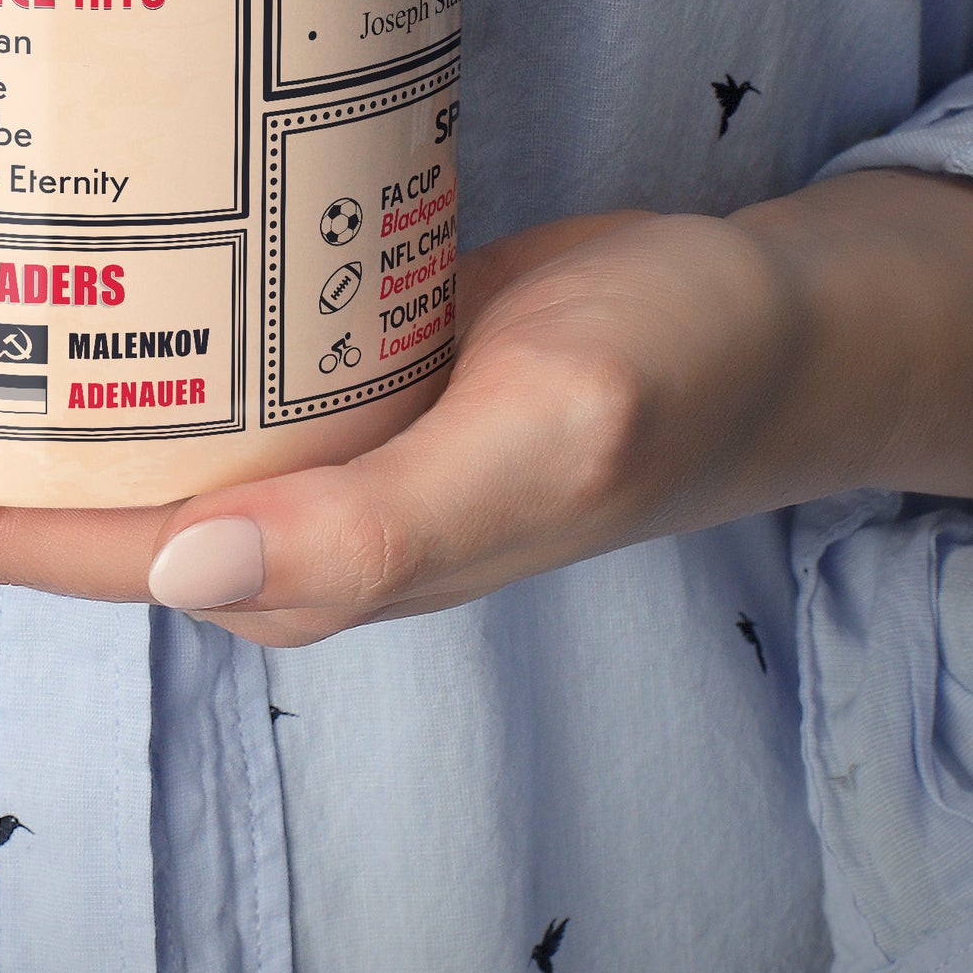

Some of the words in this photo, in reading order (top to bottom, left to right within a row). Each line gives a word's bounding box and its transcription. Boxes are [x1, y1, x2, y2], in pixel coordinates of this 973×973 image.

[10, 165, 129, 202] Eternity
[381, 182, 404, 210] FA
[408, 164, 440, 199] CUP
[381, 177, 456, 238] Blackpool
[380, 255, 437, 300] Detroit
[381, 240, 415, 273] NFL
[379, 294, 428, 333] TOUR
[432, 279, 449, 309] DE
[68, 328, 210, 360] MALENKOV
[379, 316, 441, 360] Louison
[68, 378, 206, 409] ADENAUER
